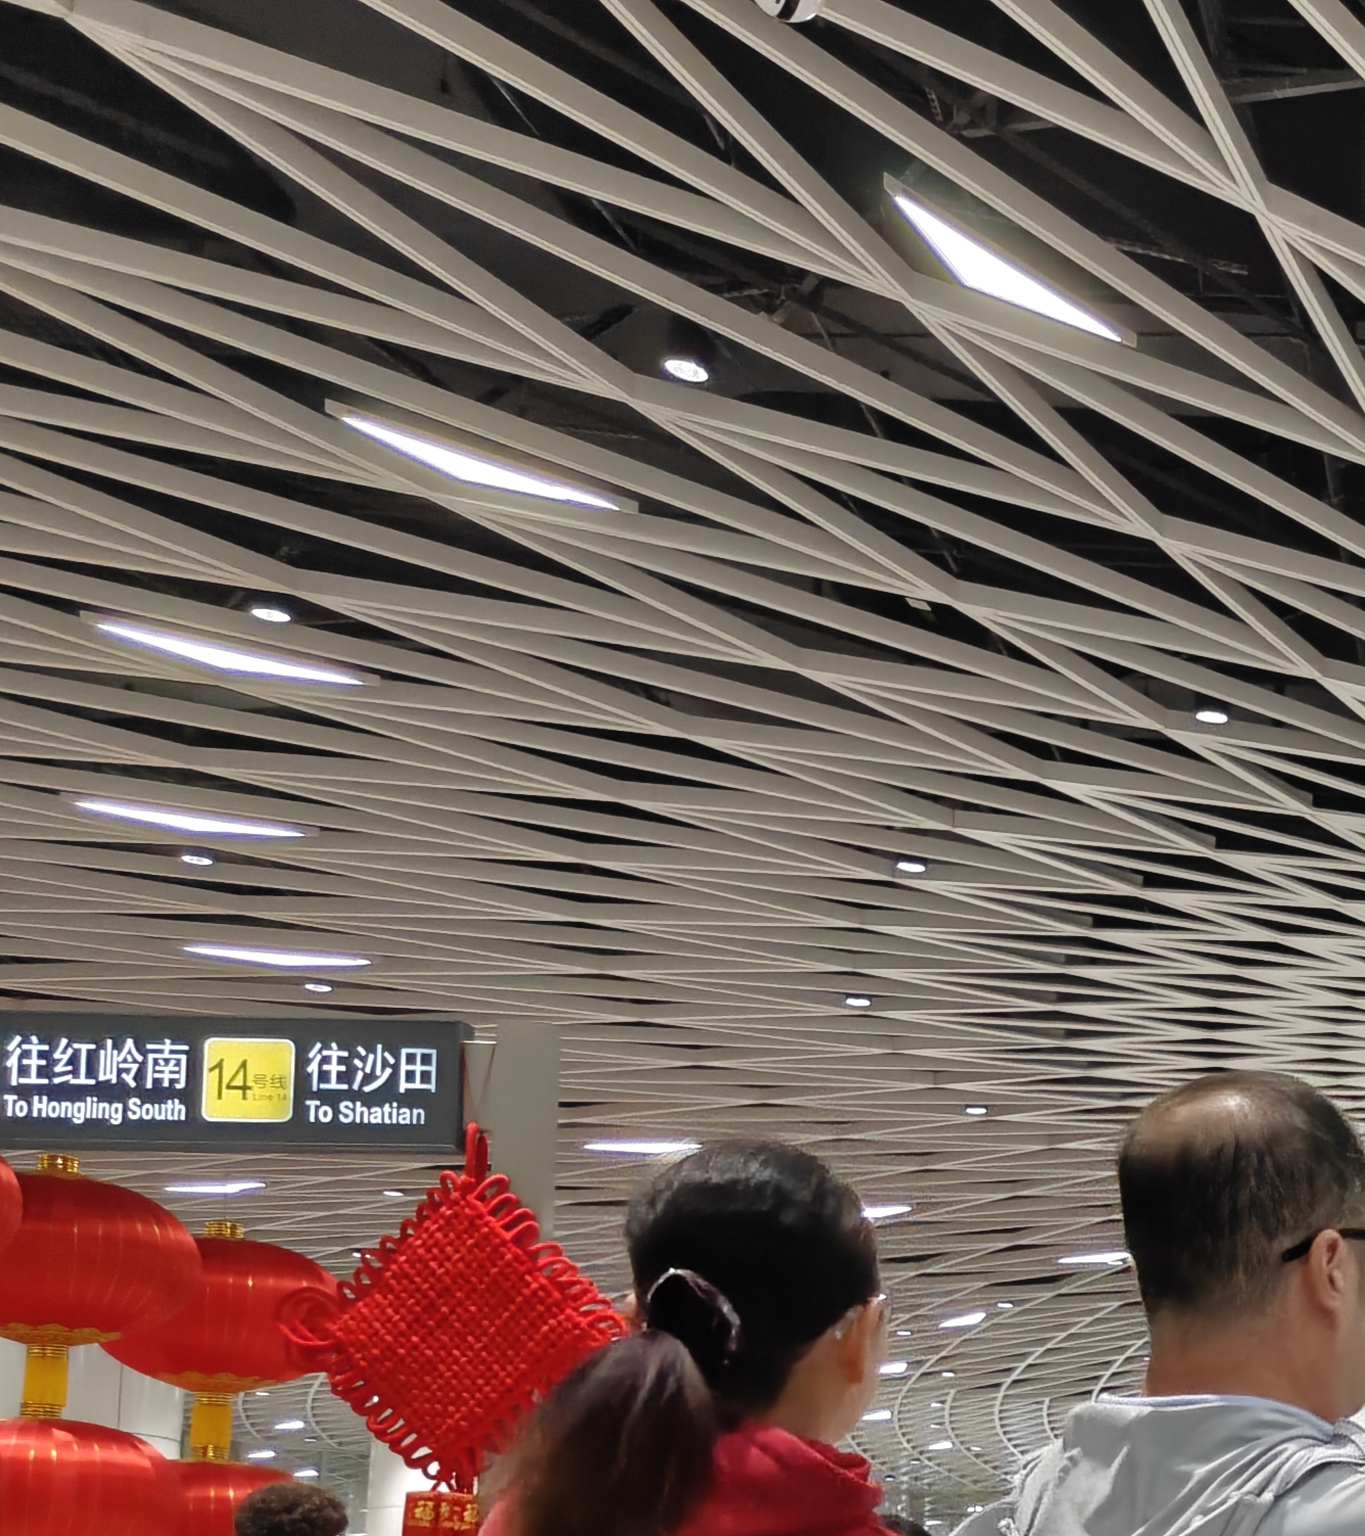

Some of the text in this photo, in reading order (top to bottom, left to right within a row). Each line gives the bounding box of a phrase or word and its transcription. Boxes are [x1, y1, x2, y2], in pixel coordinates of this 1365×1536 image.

[6, 1035, 190, 1089] 往红岭南
[306, 1042, 437, 1093] 往沙田
[3, 1094, 186, 1125] To Hongling South
[305, 1100, 425, 1125] To Shatian
